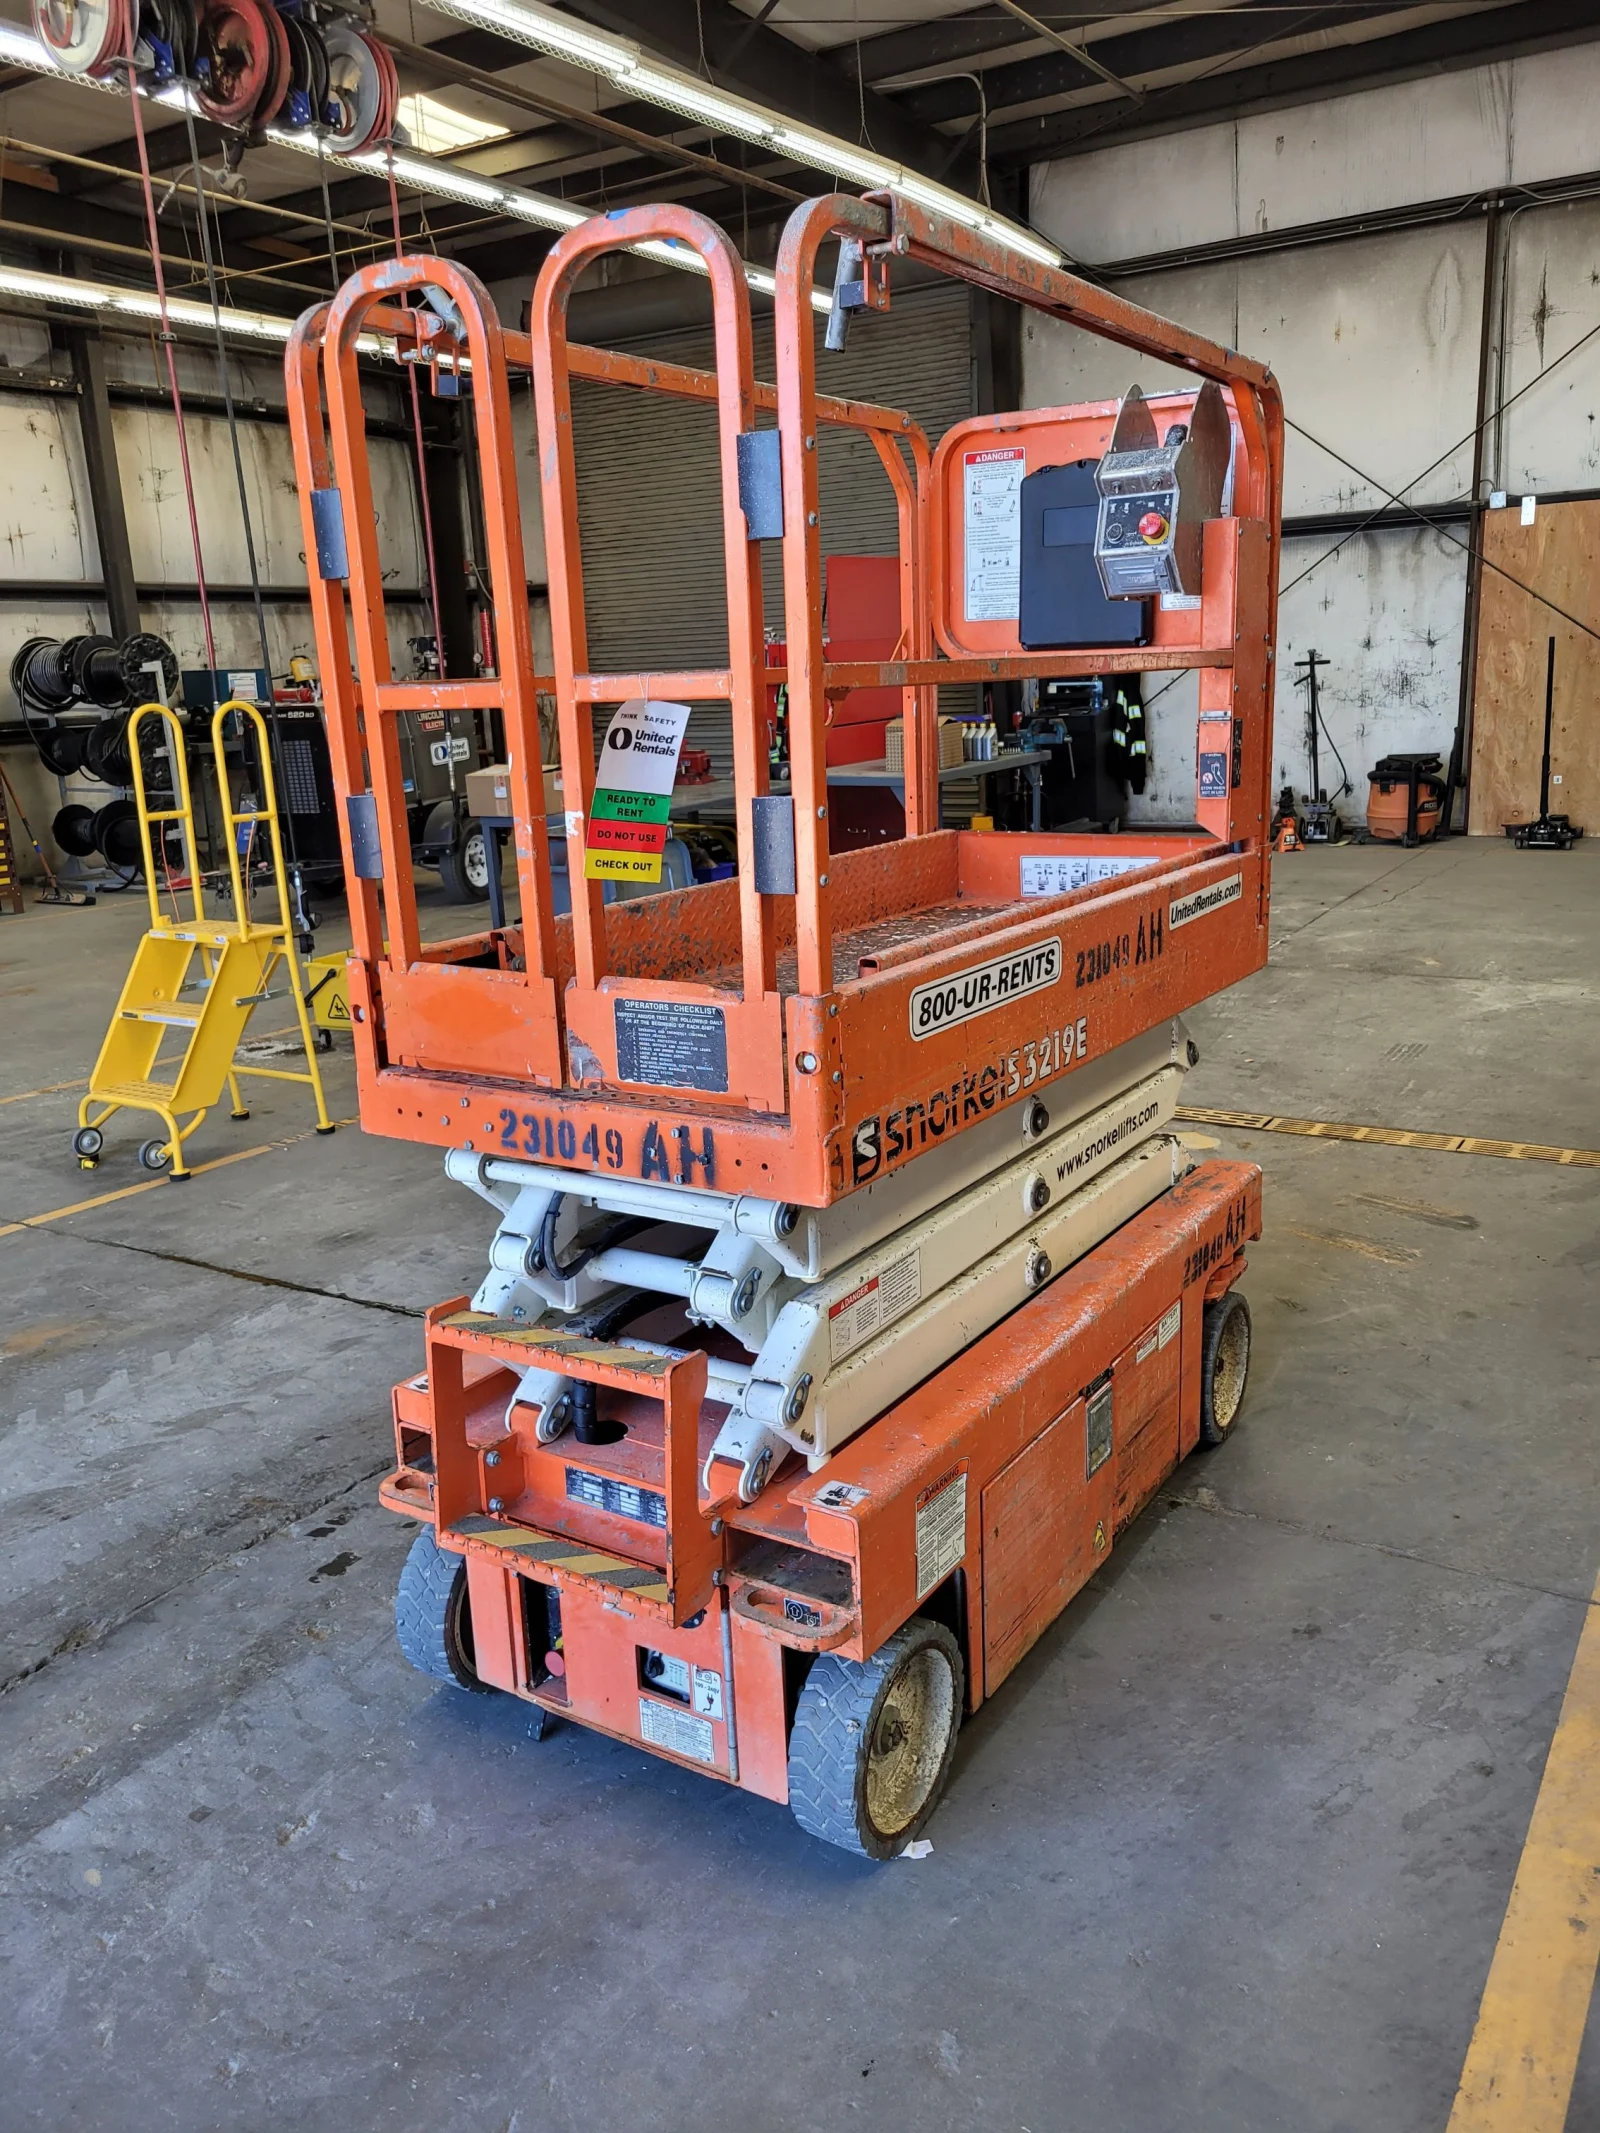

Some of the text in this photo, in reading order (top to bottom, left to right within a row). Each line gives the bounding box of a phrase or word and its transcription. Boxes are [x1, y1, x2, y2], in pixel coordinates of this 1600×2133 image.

[982, 451, 1014, 462] DANGER
[644, 715, 676, 726] SAFETY
[636, 730, 676, 744] United
[633, 742, 675, 756] Rentals
[607, 795, 655, 806] READY TO
[617, 808, 643, 817] RENT
[598, 830, 656, 842] DO NOT USE
[595, 860, 652, 871] CHECK OUT
[1170, 881, 1241, 924] UnitedRentals.com
[1076, 908, 1163, 989] 231049 AH
[919, 950, 1055, 1026] 800-UR-RENTS
[625, 1001, 716, 1015] OPERATORS CHECKLIST
[680, 1017, 708, 1025] FOLLOWING
[500, 1108, 714, 1188] 231049 AH
[1057, 1102, 1158, 1182] www.snorkellifts.com
[1226, 1196, 1246, 1248] AH
[844, 1284, 869, 1308] DANGER
[1161, 1308, 1178, 1329] BATTERY
[929, 1466, 960, 1498] WARNING
